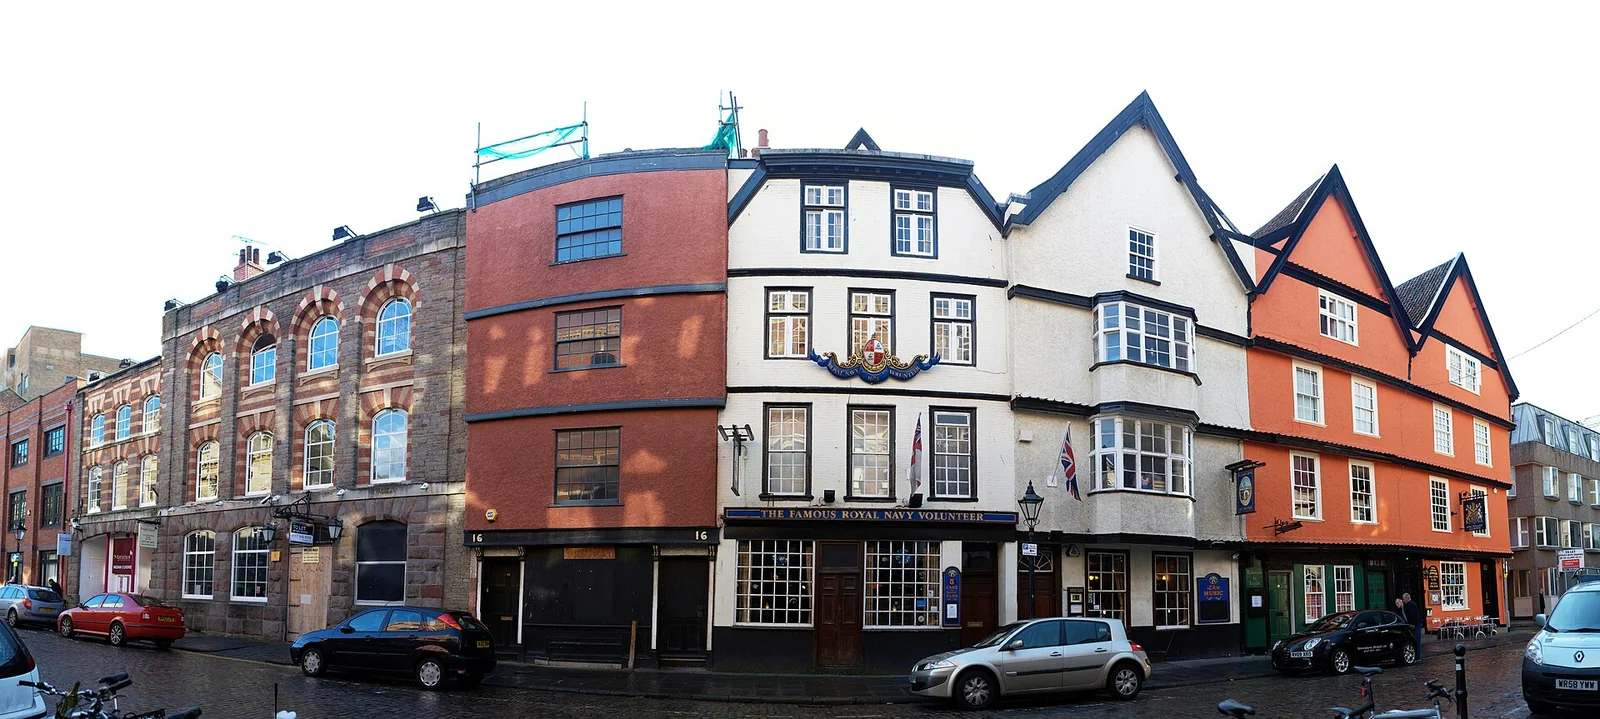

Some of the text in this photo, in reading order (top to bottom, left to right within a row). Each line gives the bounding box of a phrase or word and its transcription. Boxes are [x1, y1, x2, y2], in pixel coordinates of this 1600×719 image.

[760, 510, 984, 521] THE FAMOUS ROYAL NAVY VOLUNTEER
[472, 533, 483, 543] 16
[695, 531, 708, 540] 16
[1559, 680, 1595, 689] WR58 YWW
